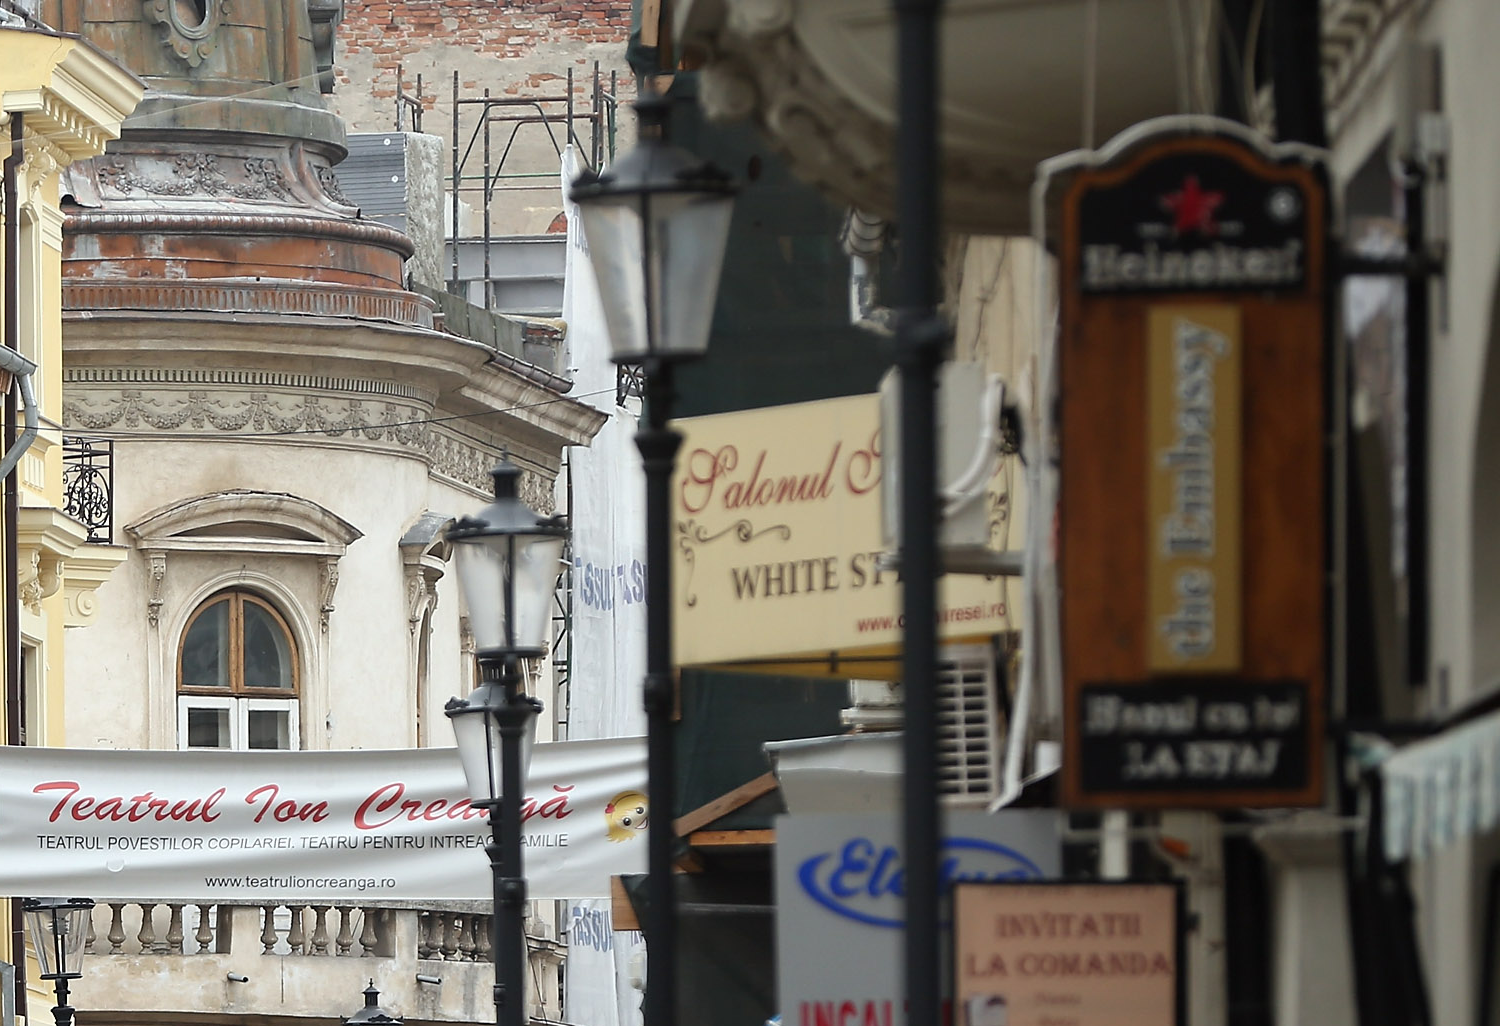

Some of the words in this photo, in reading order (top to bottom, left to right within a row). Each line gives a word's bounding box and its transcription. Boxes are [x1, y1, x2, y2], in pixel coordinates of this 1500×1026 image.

[681, 441, 842, 513] Salonul
[732, 556, 839, 600] WHITE
[851, 550, 904, 588] ST
[32, 780, 226, 823] Teatrul
[245, 783, 329, 824] Ion
[354, 782, 575, 830] Creagă
[37, 835, 104, 850] TEATRUL
[107, 836, 203, 851] POVESTILOR
[208, 836, 295, 850] COPILARIEI.
[300, 836, 359, 850] TEATRU
[363, 835, 426, 849] PENTRU
[430, 834, 497, 849] INTREA
[518, 833, 569, 848] AMILIE
[205, 874, 396, 891] www.teatrulioncreanga.ro
[965, 953, 1007, 977] LA
[1018, 952, 1172, 977] COMANDA
